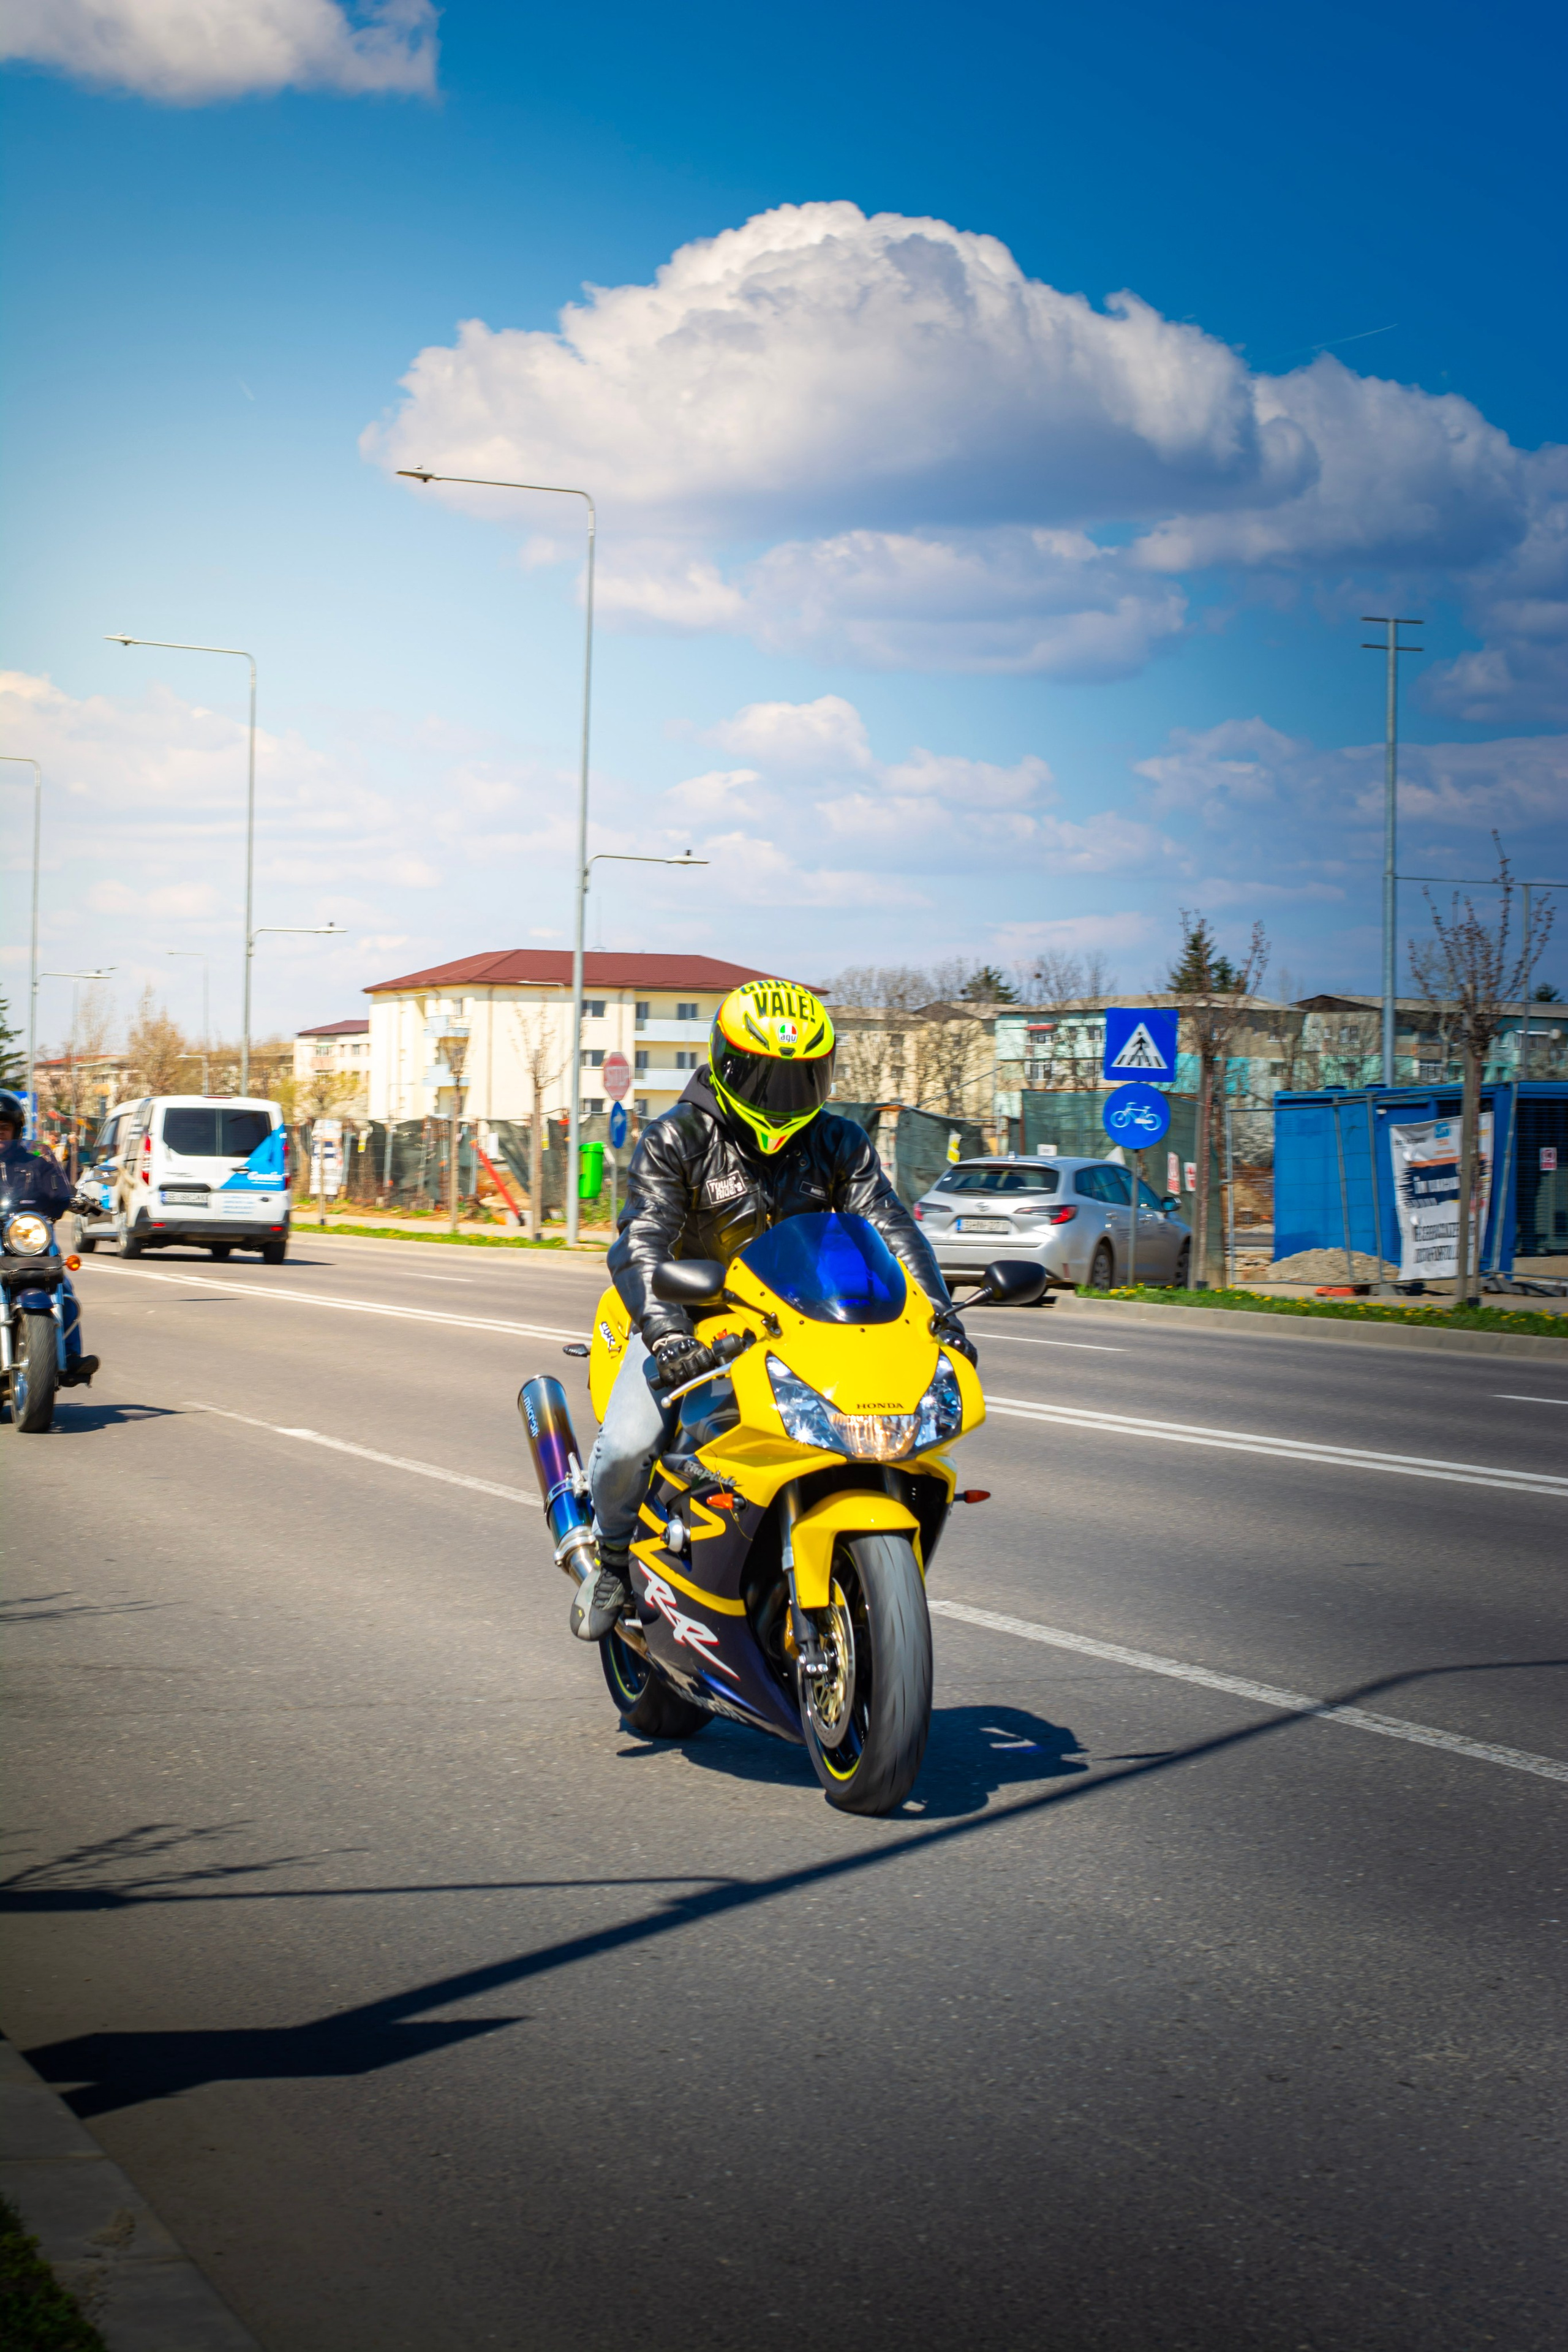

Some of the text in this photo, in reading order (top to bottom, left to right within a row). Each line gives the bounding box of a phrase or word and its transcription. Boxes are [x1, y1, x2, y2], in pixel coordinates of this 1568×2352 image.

[753, 992, 815, 1023] VALE!
[780, 1034, 796, 1044] agv
[523, 1395, 539, 1438] micron
[638, 1559, 741, 1681] RR
